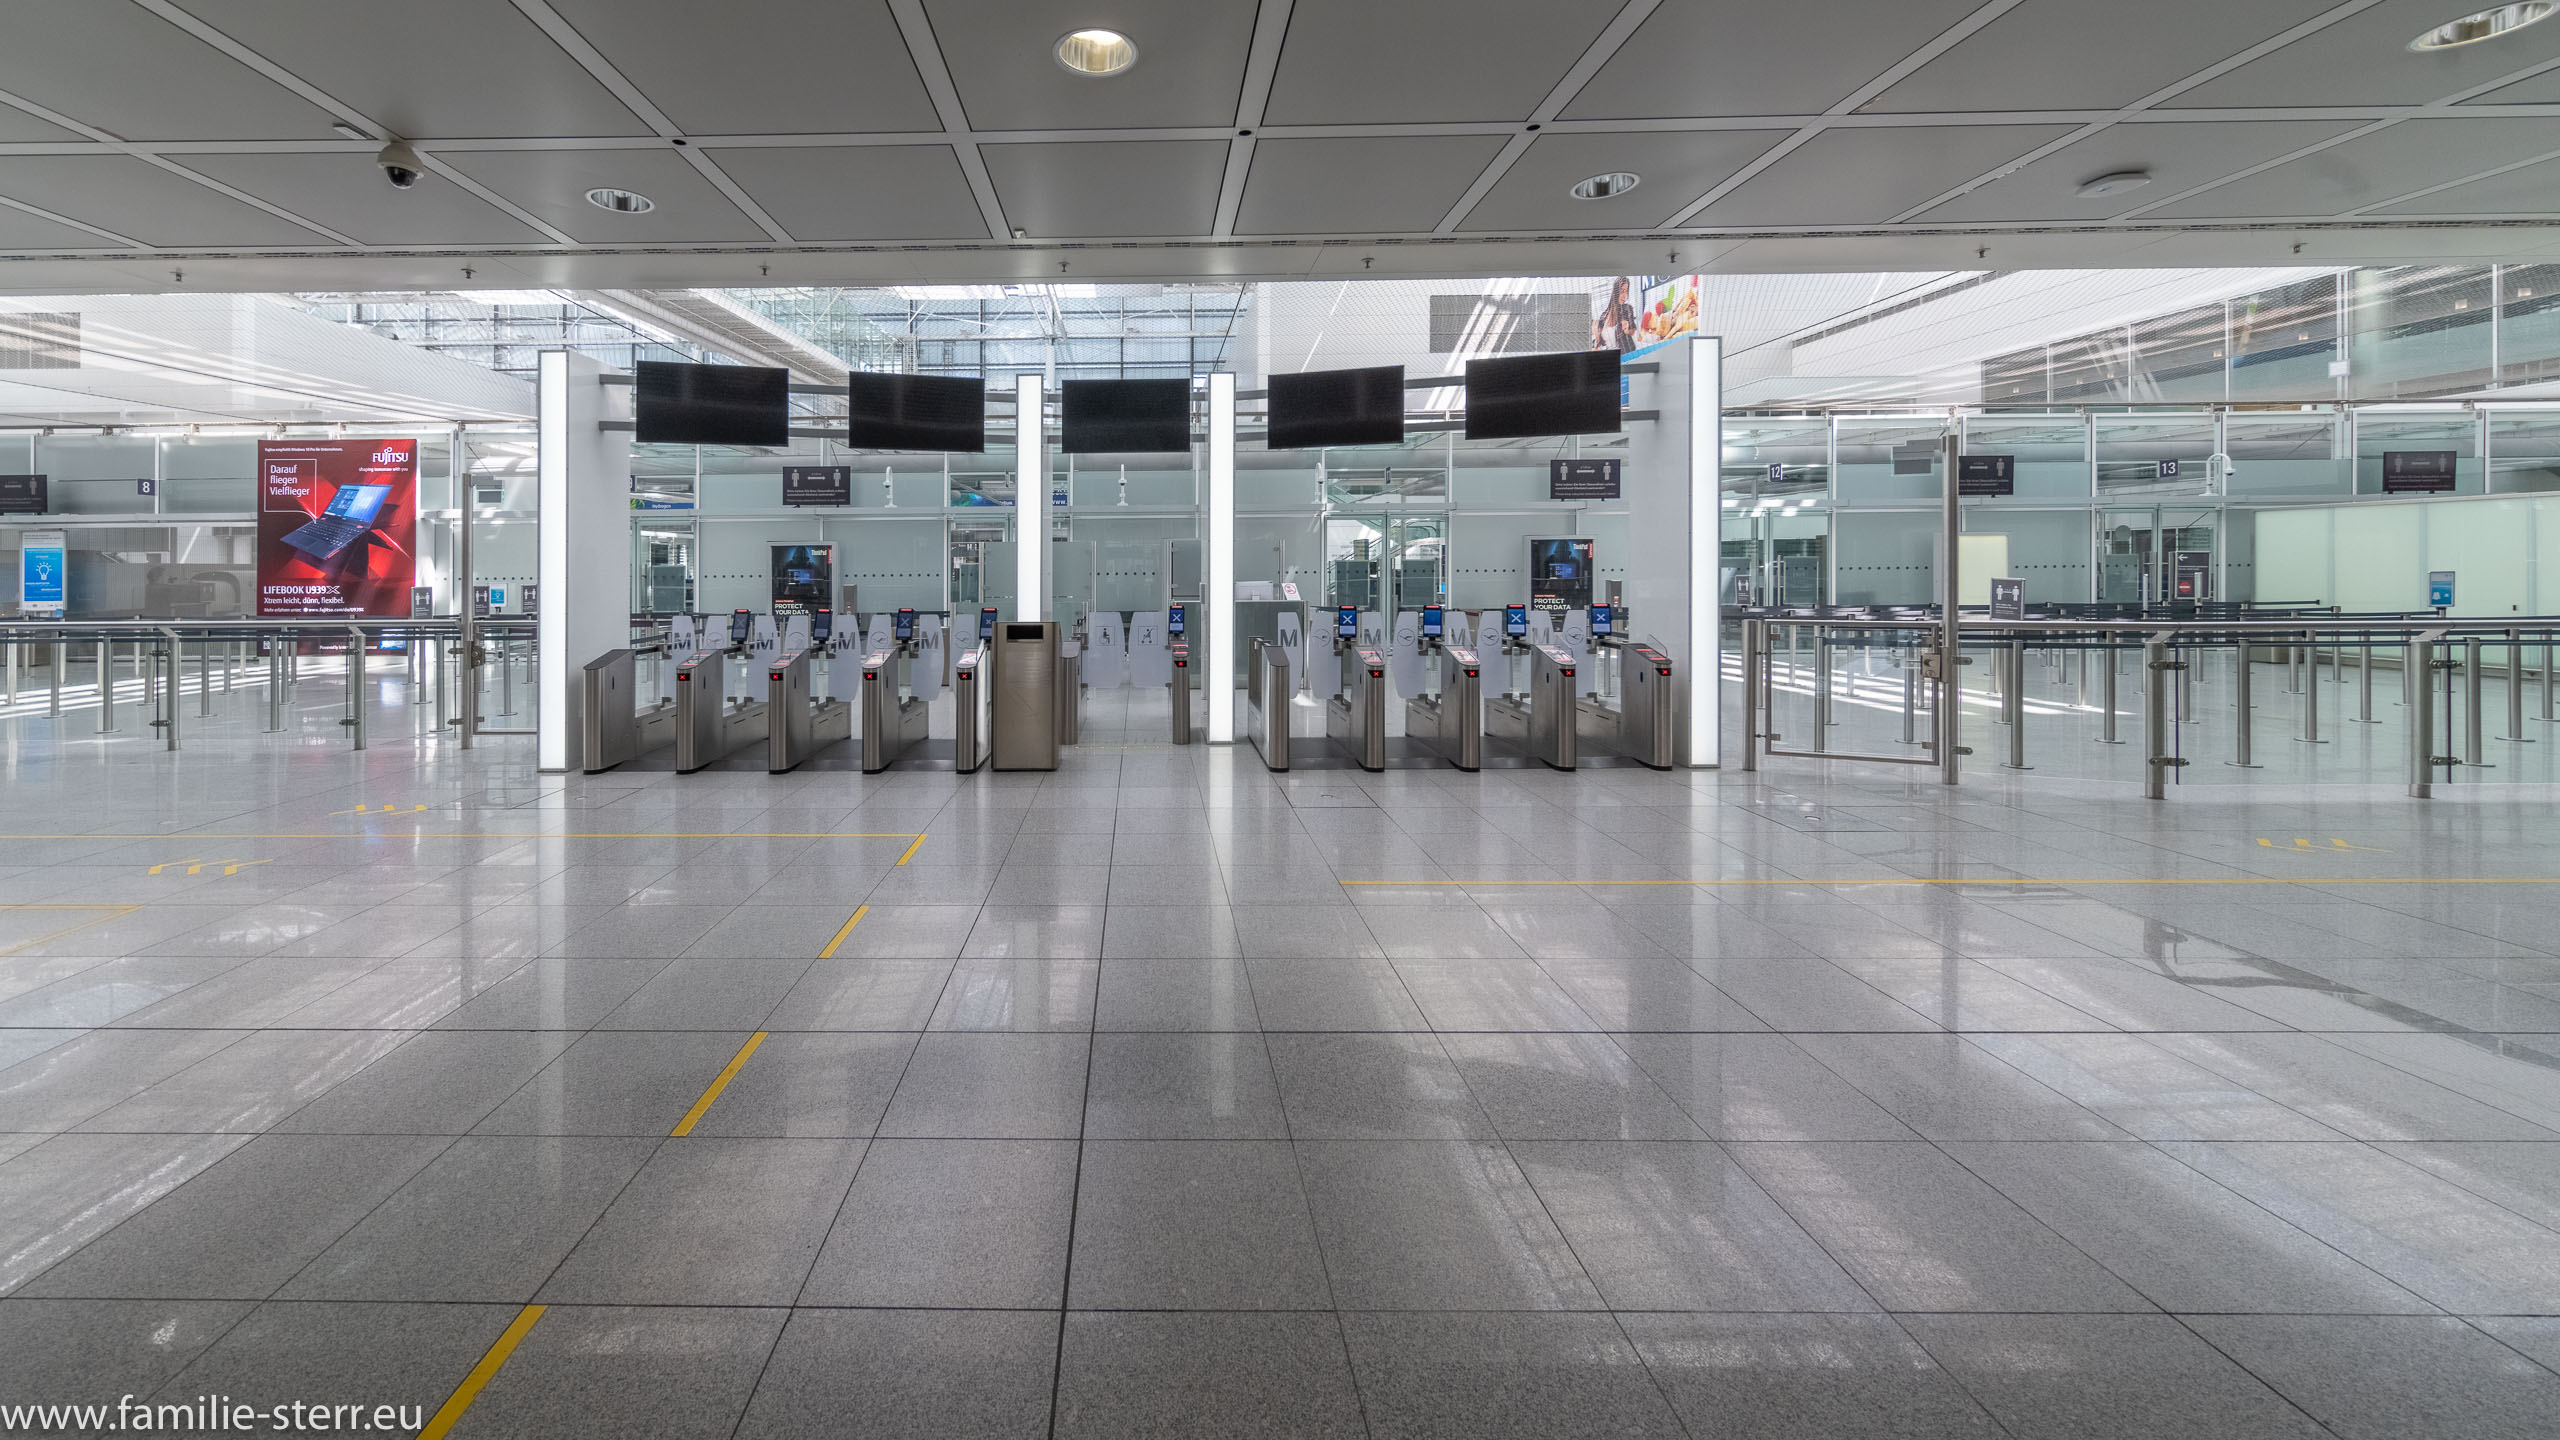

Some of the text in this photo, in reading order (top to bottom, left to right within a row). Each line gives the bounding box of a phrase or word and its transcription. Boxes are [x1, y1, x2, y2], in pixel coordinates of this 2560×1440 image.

[372, 447, 409, 465] FUJITSU
[270, 464, 298, 474] Darauf
[1770, 465, 1780, 479] 12
[2161, 463, 2176, 474] 13
[270, 475, 298, 486] fliegen
[142, 481, 150, 493] 8
[269, 487, 310, 498] Vielflieger
[263, 585, 304, 594] LIFEBOOK
[283, 597, 302, 605] leicht,
[303, 597, 320, 605] dünn,
[838, 631, 855, 649] M
[921, 631, 938, 649] M
[1280, 629, 1297, 647] M
